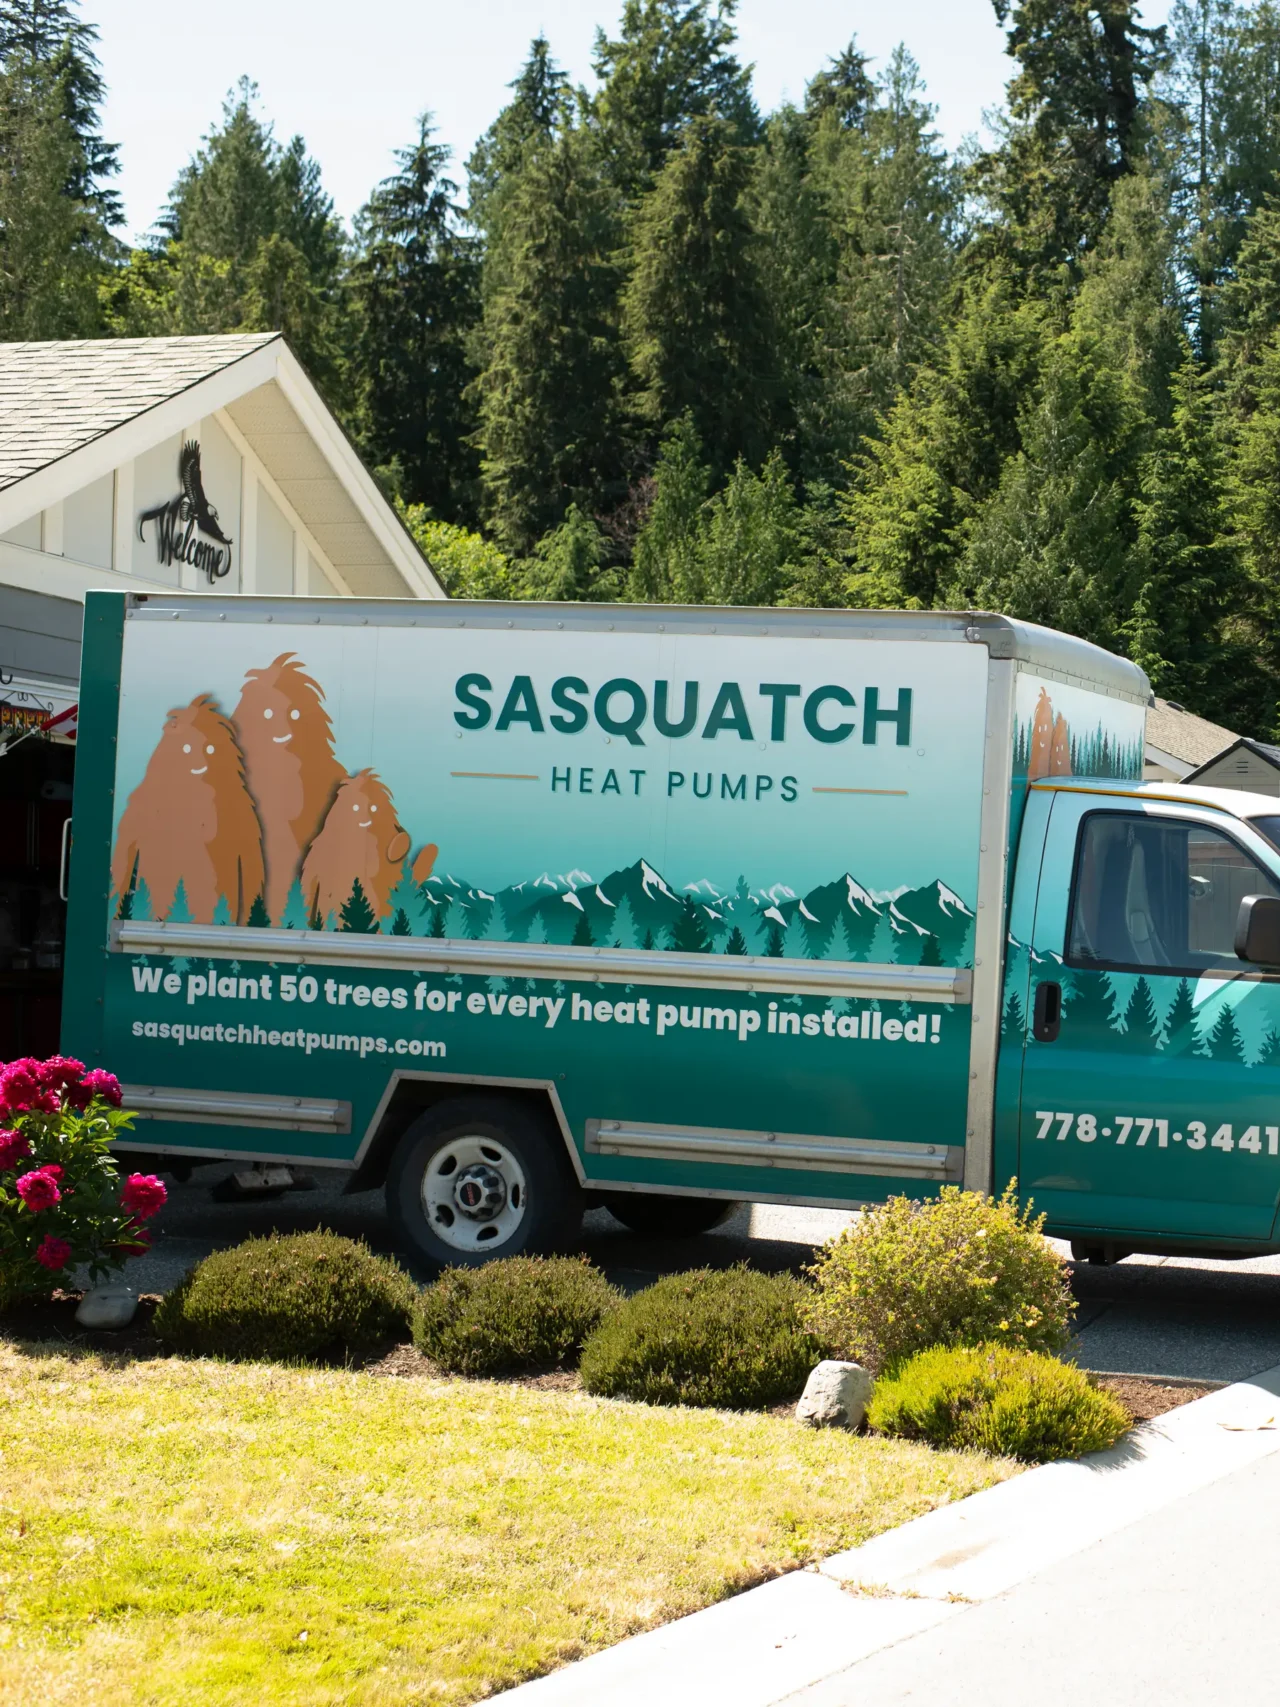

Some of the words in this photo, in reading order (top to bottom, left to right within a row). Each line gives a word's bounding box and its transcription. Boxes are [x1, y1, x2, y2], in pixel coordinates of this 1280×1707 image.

[139, 493, 231, 584] Welcome
[454, 673, 913, 746] SASQUATCH
[551, 767, 647, 796] HEAT
[667, 771, 799, 802] PUMPS
[132, 966, 182, 994] We
[187, 970, 272, 1004] plant
[280, 975, 318, 1003] 50
[324, 979, 408, 1010] trees
[414, 981, 461, 1013] for
[466, 993, 566, 1029] every
[571, 992, 650, 1025] heat
[656, 1004, 761, 1041] pump
[768, 1001, 942, 1043] installed!
[132, 1019, 447, 1058] sasquatchheatpumps.com
